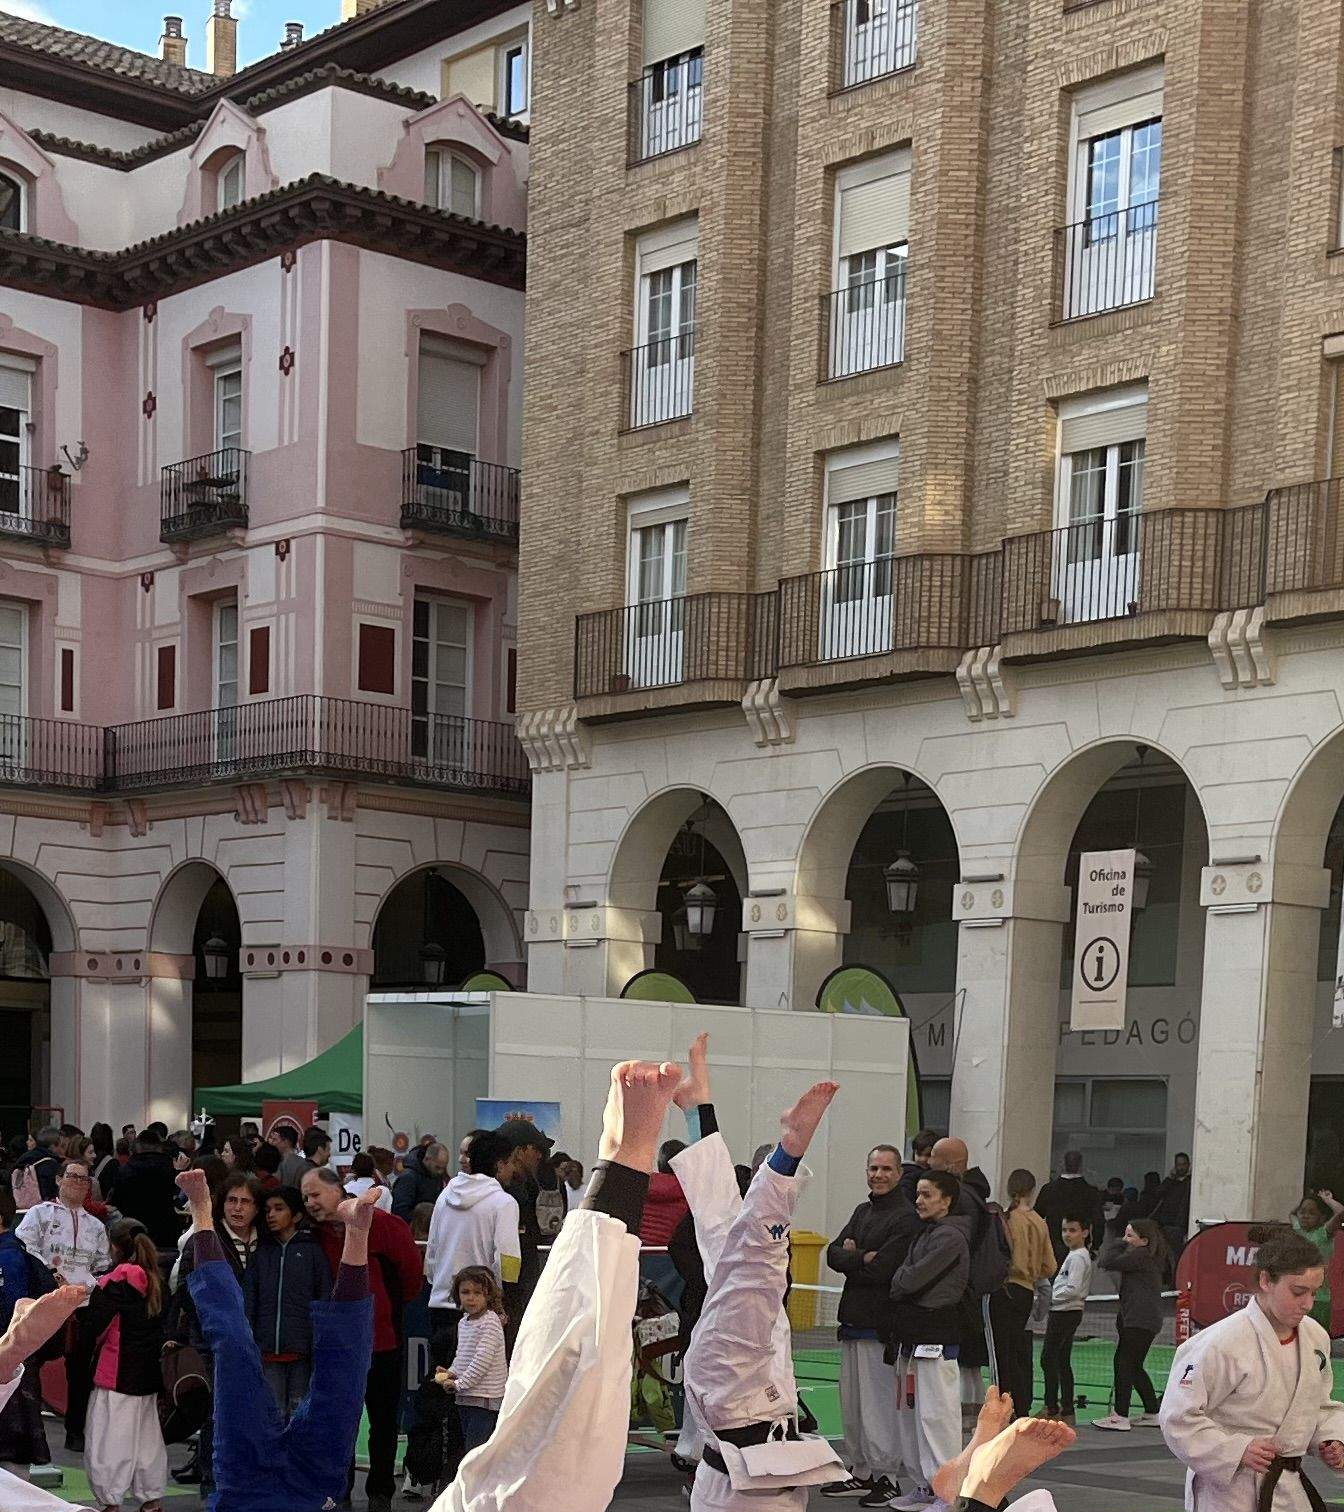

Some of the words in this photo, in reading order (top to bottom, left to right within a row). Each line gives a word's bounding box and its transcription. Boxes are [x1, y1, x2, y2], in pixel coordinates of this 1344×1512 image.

[1089, 868, 1126, 882] Oficina
[1111, 884, 1126, 897] de
[1082, 902, 1124, 914] Turismo
[1059, 1010, 1197, 1046] PEDAGÓ
